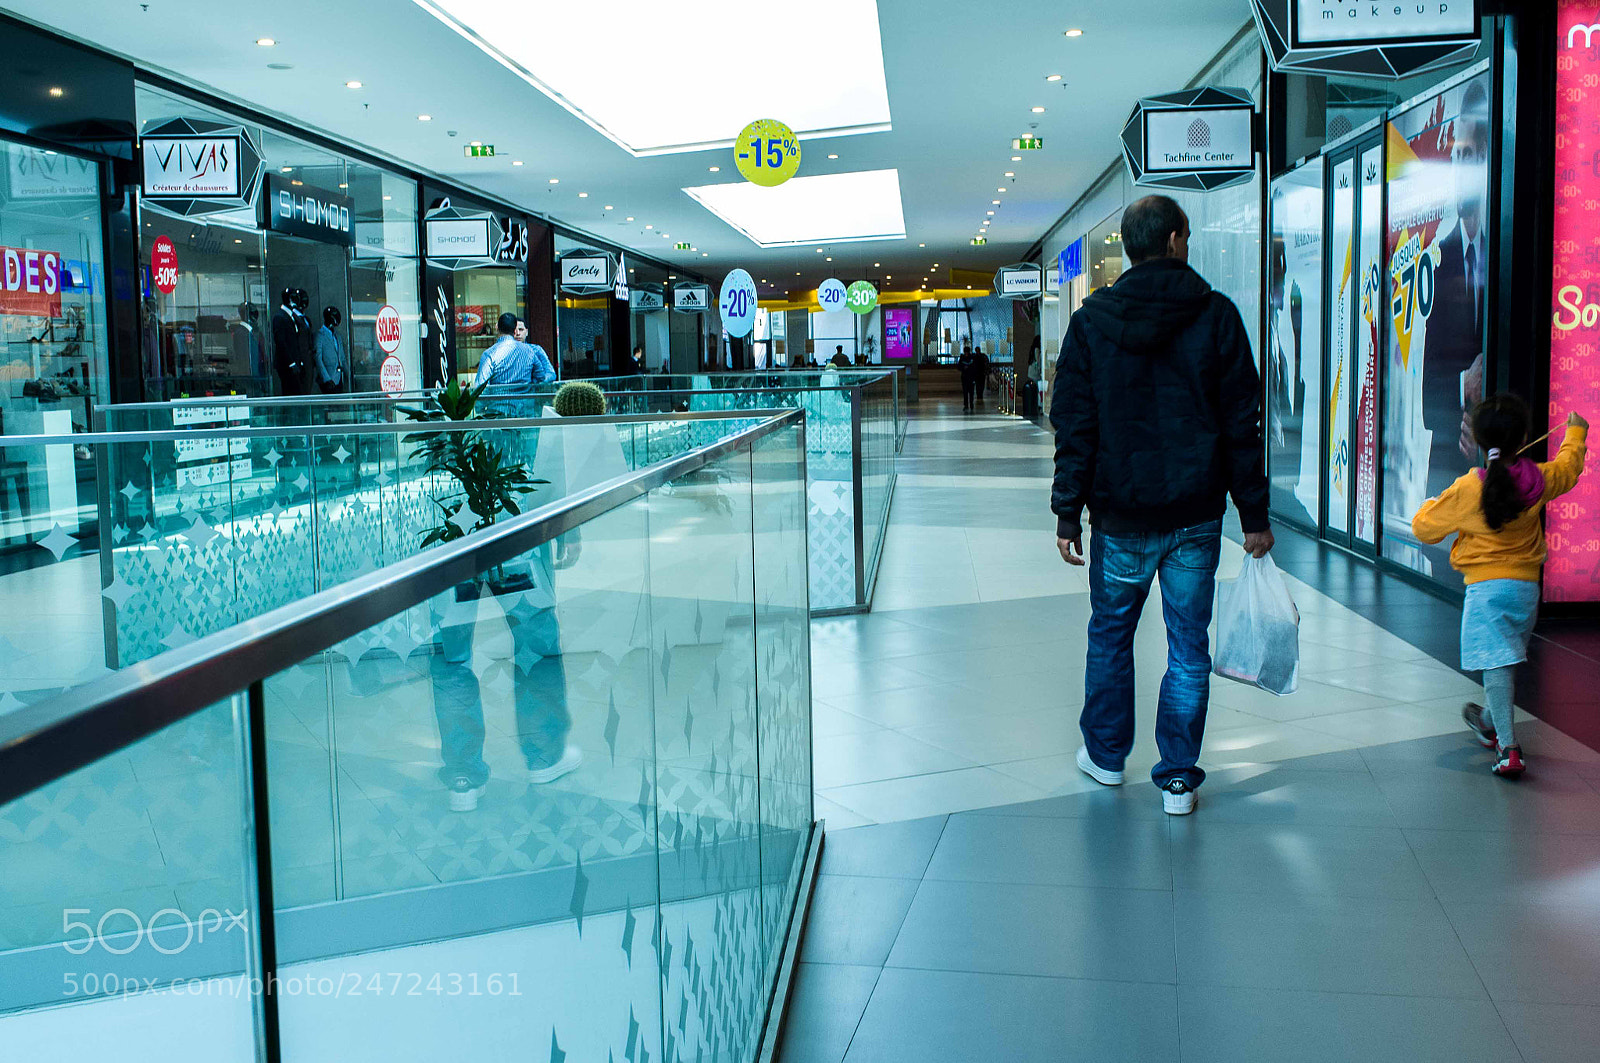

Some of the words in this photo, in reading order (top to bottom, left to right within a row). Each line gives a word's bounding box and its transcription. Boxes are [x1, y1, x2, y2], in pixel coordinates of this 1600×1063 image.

[1322, 3, 1448, 19] makeup
[739, 137, 797, 168] -15%
[1163, 152, 1201, 163] Tachfine
[1204, 151, 1235, 161] Center
[153, 143, 229, 180] VIVAS
[152, 183, 181, 192] Créateur
[183, 183, 191, 192] de
[192, 183, 229, 192] chaussures
[280, 190, 350, 232] SHOMOD
[0, 249, 57, 295] DES
[155, 267, 177, 285] -50%
[569, 265, 600, 277] Carly
[679, 298, 701, 306] adidas
[722, 288, 755, 317] -20%
[819, 288, 846, 303] -20%
[847, 289, 876, 306] -30%
[378, 316, 400, 342] SOLDES
